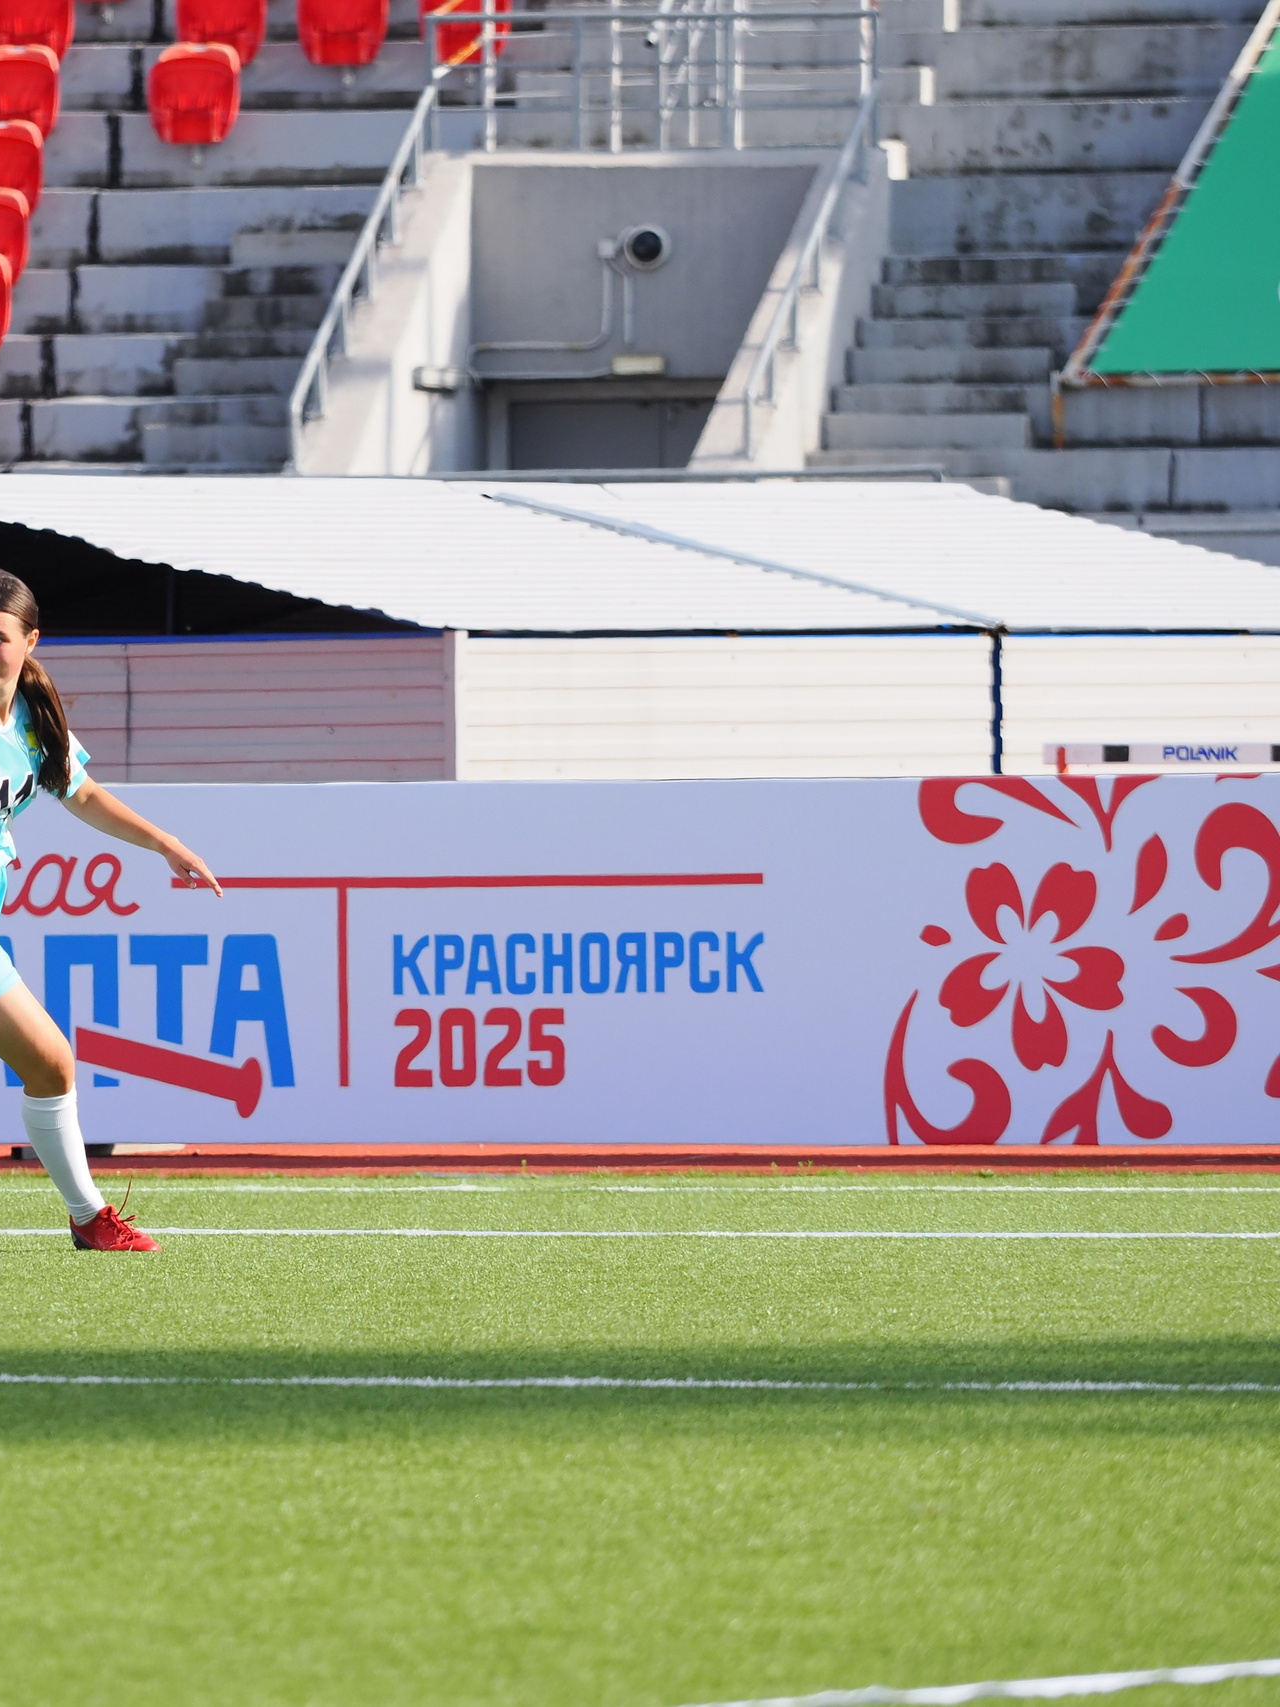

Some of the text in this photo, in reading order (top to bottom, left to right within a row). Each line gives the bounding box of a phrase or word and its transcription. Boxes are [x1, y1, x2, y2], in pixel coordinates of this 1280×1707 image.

[1163, 745, 1238, 761] POLANIK
[392, 931, 764, 996] КРАСНОЯРСК
[394, 1007, 566, 1088] 2025
